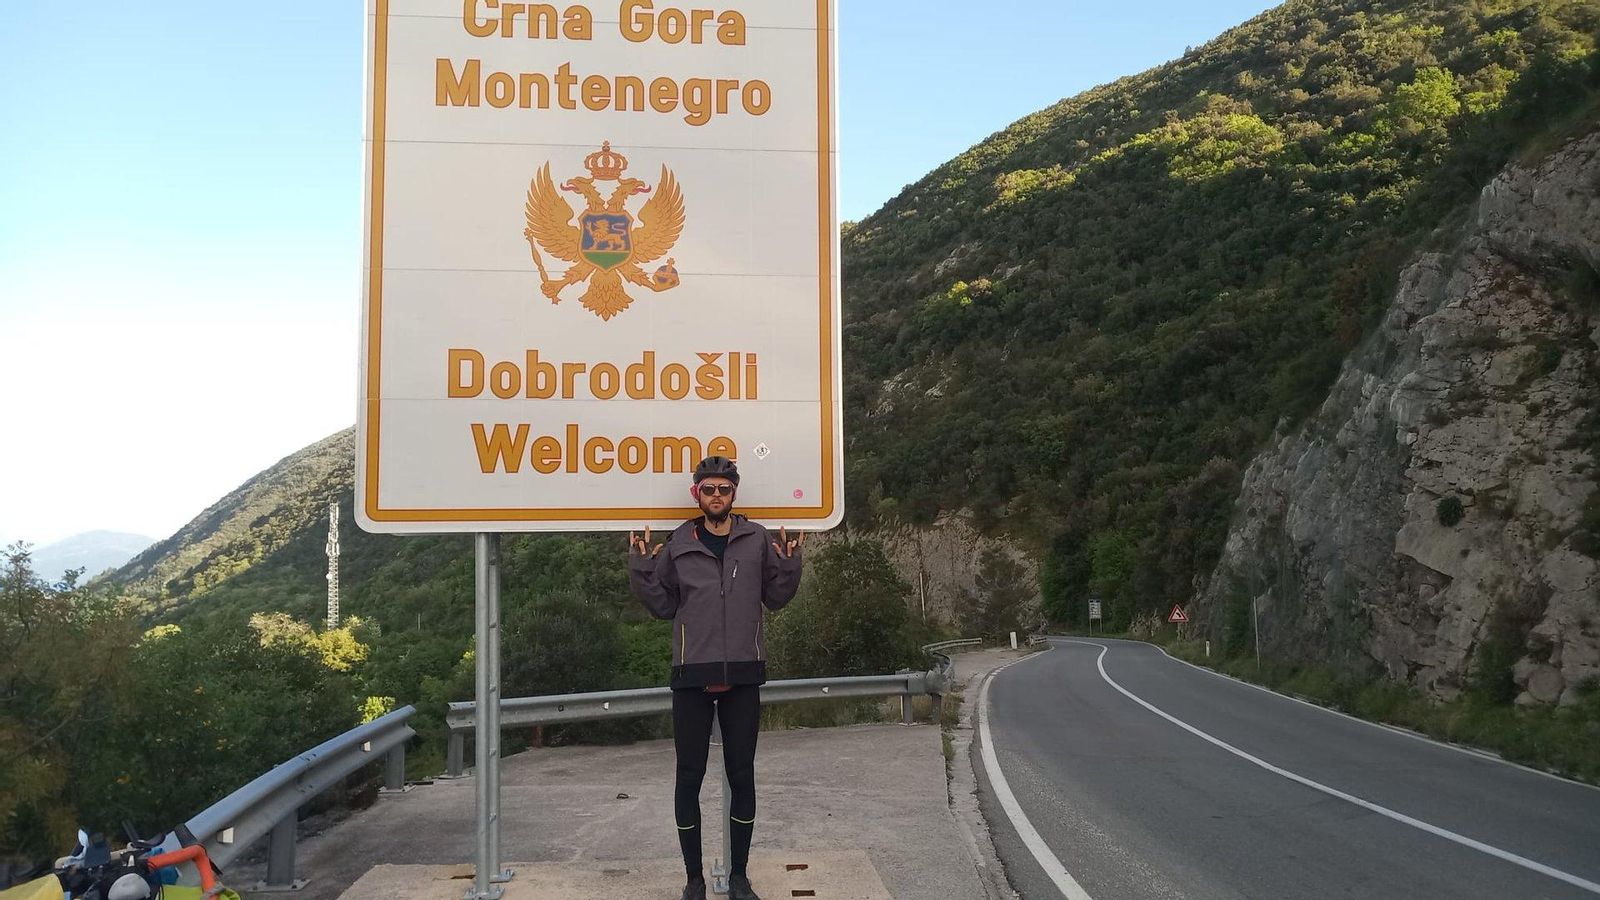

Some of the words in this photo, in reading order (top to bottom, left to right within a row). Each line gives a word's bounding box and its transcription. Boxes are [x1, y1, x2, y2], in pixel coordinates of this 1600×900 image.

[463, 0, 592, 40] Crna
[619, 0, 746, 46] Gora
[435, 58, 771, 126] Montenegro
[447, 348, 758, 400] Dobrodošli
[471, 423, 737, 474] Welcome
